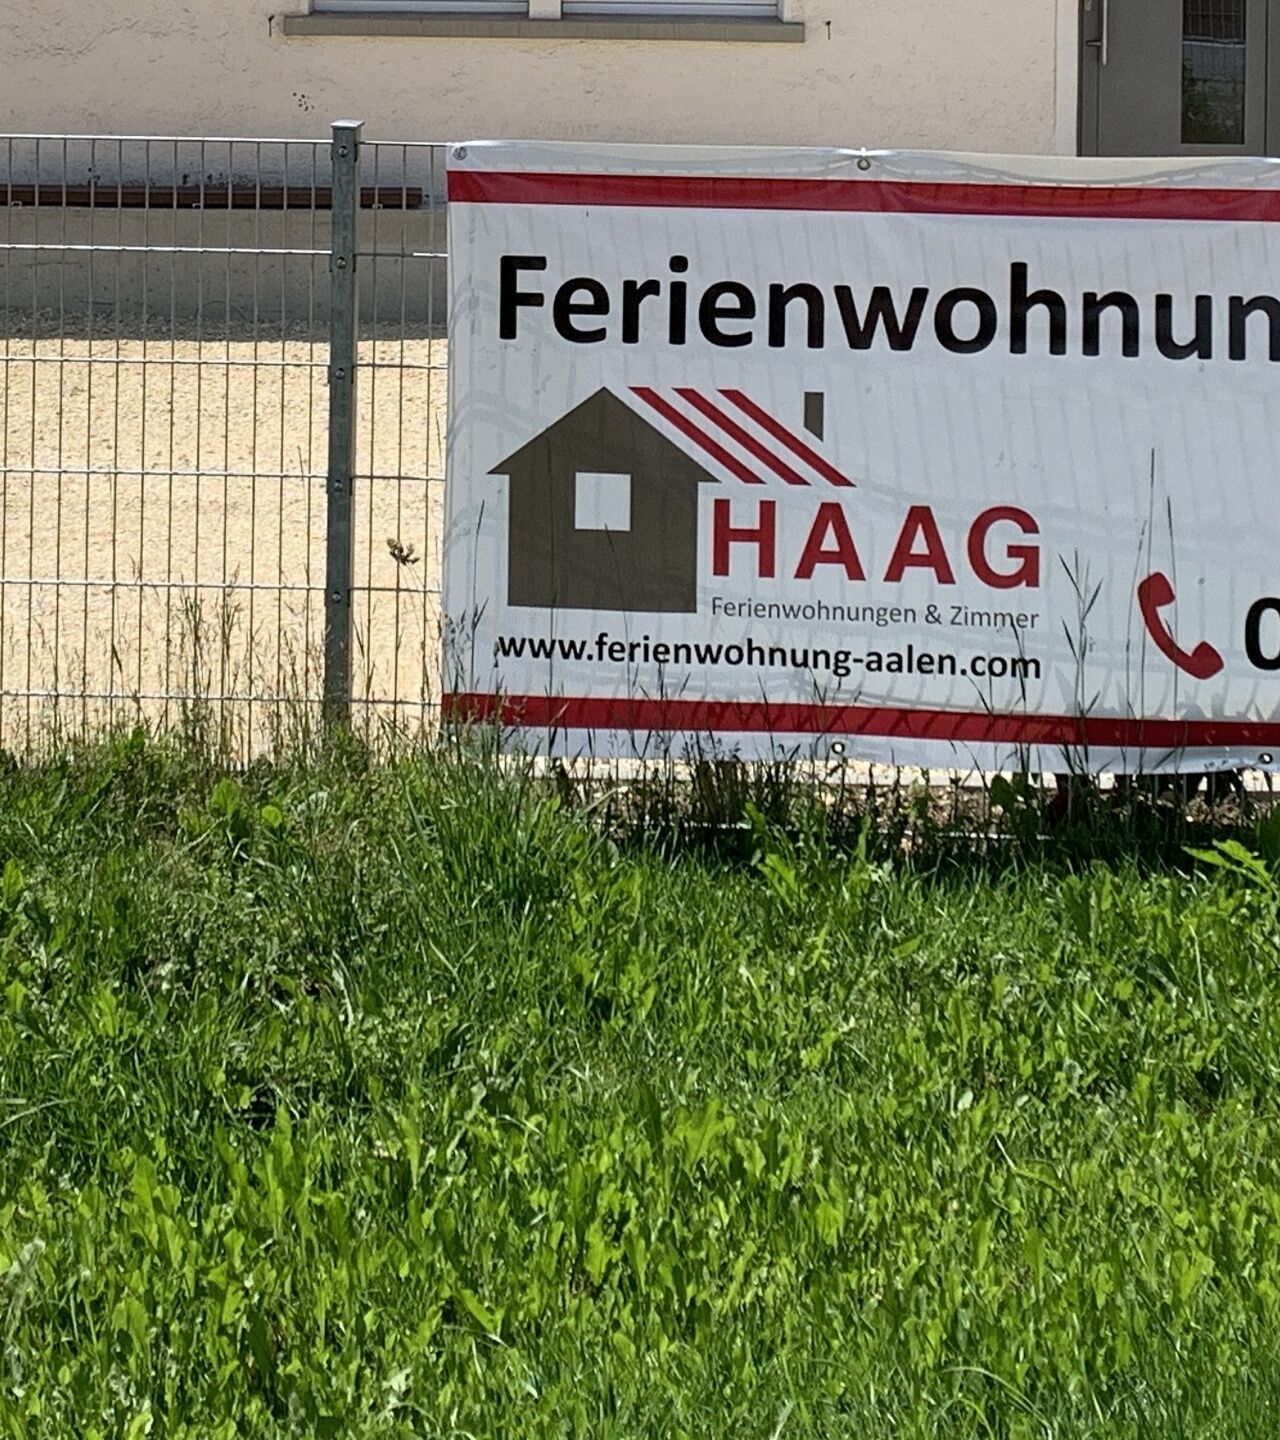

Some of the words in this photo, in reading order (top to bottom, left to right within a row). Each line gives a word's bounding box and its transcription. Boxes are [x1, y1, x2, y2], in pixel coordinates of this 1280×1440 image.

[713, 499, 1039, 589] HAAG
[712, 597, 916, 626] Ferienwohnungen
[924, 604, 943, 625] &
[950, 605, 1039, 630] Zimmer
[498, 632, 1041, 679] www.ferienwohnung-aalen.com
